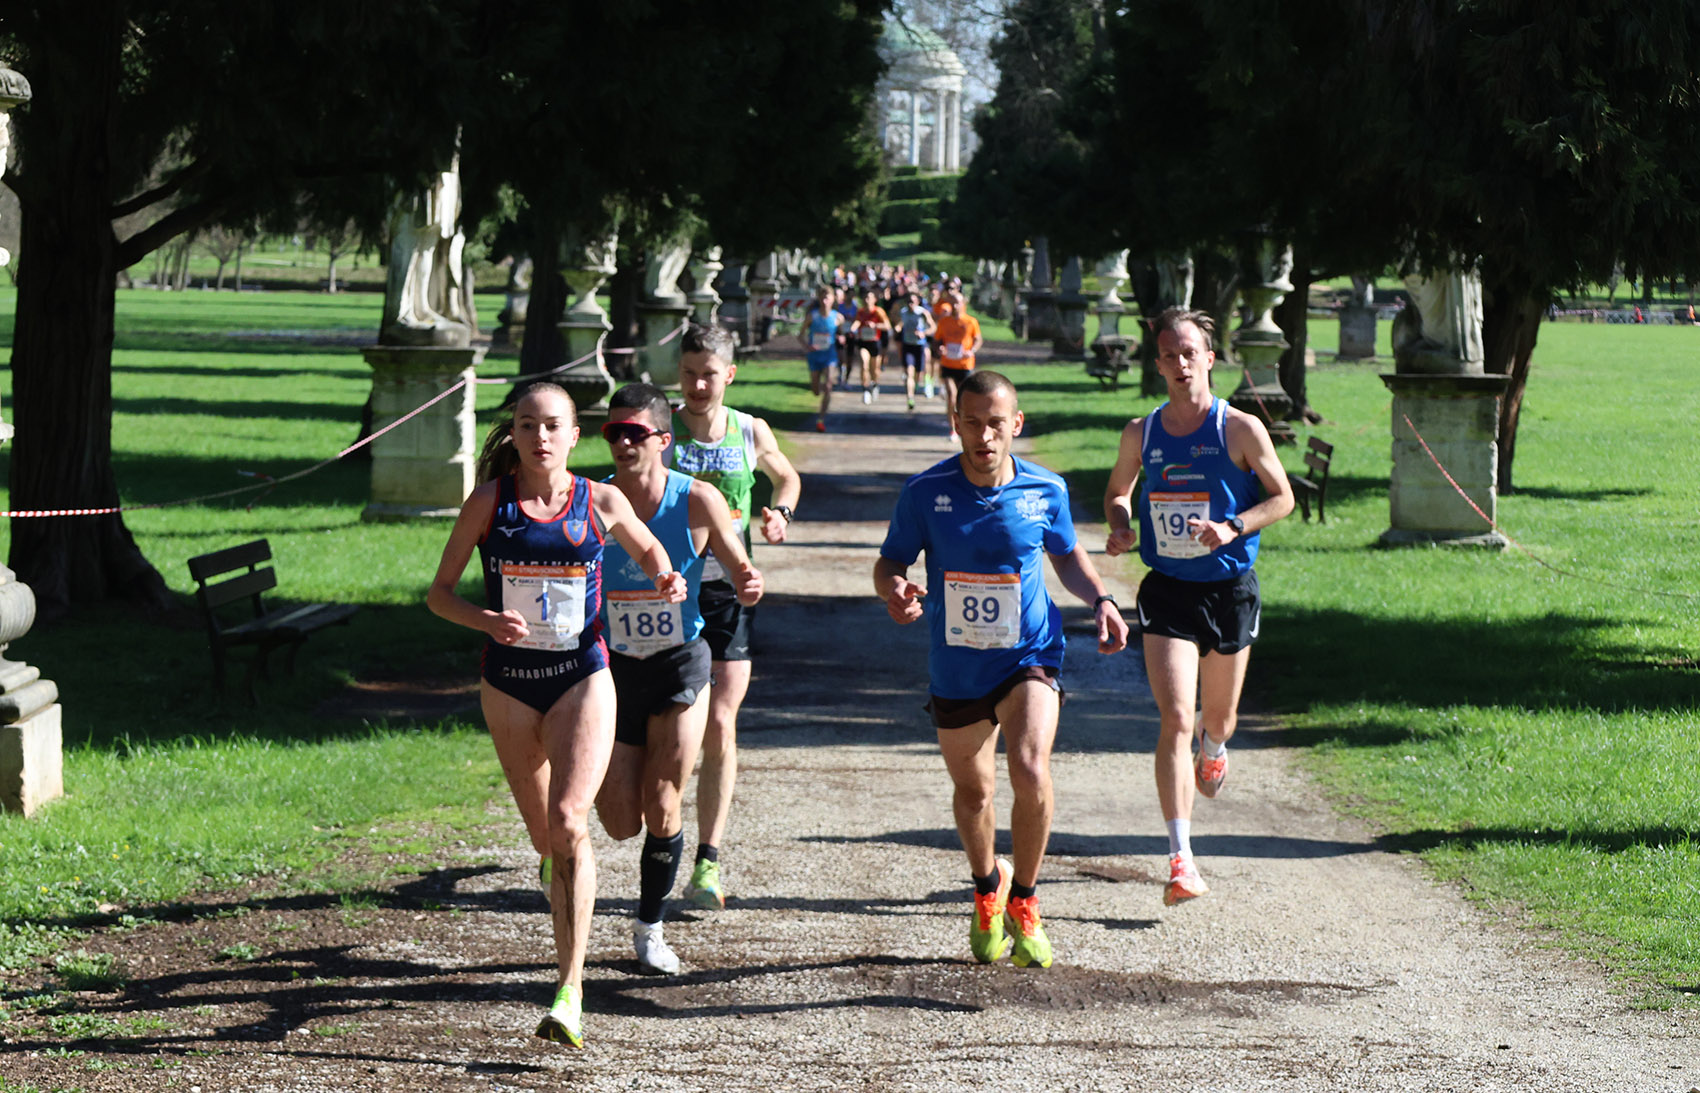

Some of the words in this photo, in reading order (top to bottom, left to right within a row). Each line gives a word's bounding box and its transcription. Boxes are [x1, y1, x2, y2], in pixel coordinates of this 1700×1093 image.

[678, 444, 742, 460] Vicenza
[535, 591, 548, 621] 1
[962, 595, 1000, 623] 89
[618, 611, 675, 637] 188
[503, 658, 579, 680] CARABINIERI
